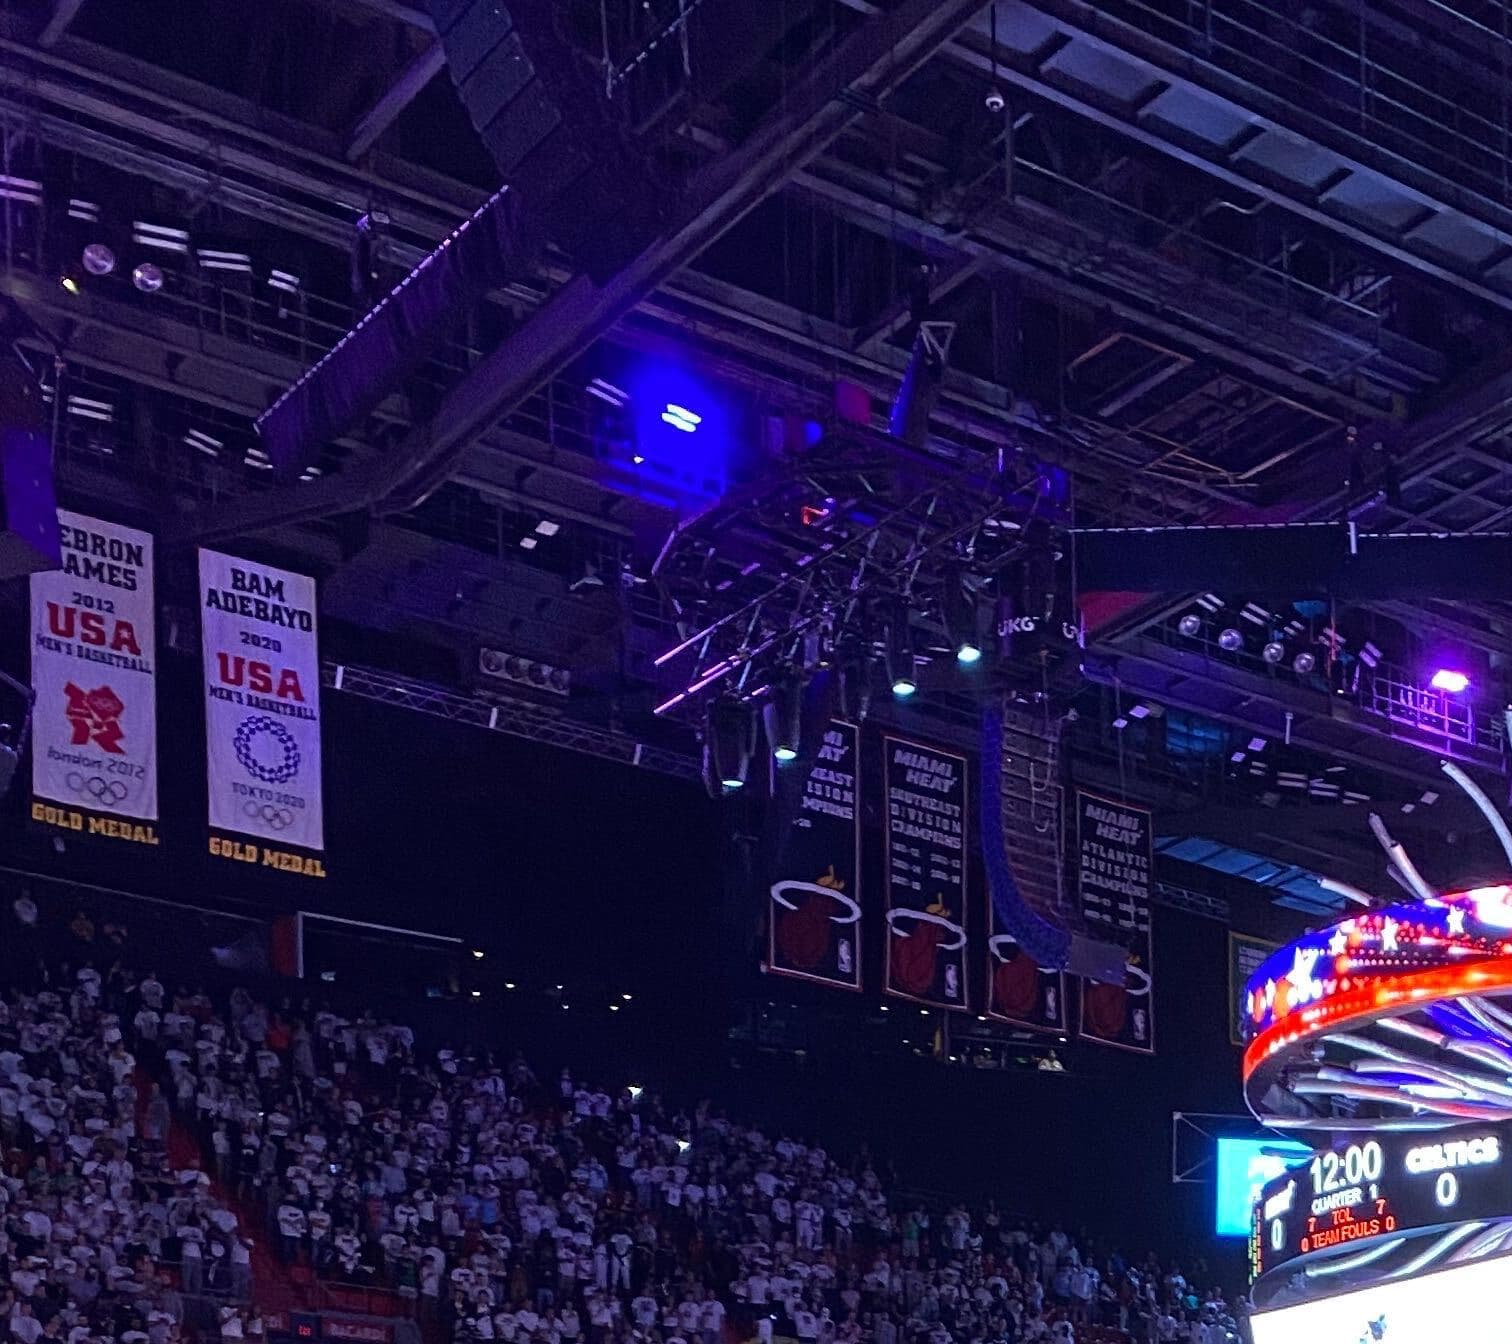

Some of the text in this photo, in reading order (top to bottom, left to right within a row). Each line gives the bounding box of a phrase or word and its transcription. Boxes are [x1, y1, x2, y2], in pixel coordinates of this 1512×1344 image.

[60, 525, 144, 567] EBRON
[63, 552, 137, 591] AMES
[231, 568, 285, 603] BAM
[72, 591, 115, 614] 2012
[206, 588, 312, 632] ADEBAYO
[47, 601, 142, 655] USA
[240, 631, 282, 653] 2020
[217, 652, 304, 701] USA
[894, 749, 953, 778] MIAMI
[906, 768, 957, 793] HEAT
[32, 802, 159, 844] GOLD MEDAL
[890, 803, 961, 834] DIVISION
[1085, 804, 1139, 830] MIAMI
[1096, 823, 1145, 846] HEAT
[209, 837, 326, 877] GOLD MEDAL
[1082, 840, 1148, 869] ATLANTIC
[1082, 854, 1148, 884] DIVISION
[1310, 1140, 1382, 1194] 12:00
[1405, 1136, 1499, 1174] CELTICS
[1311, 1186, 1362, 1216] QUARTER
[1435, 1172, 1457, 1206] 0
[1332, 1207, 1354, 1226] TOL
[1271, 1219, 1282, 1250] 0
[1311, 1219, 1380, 1250] TEAM FOULS
